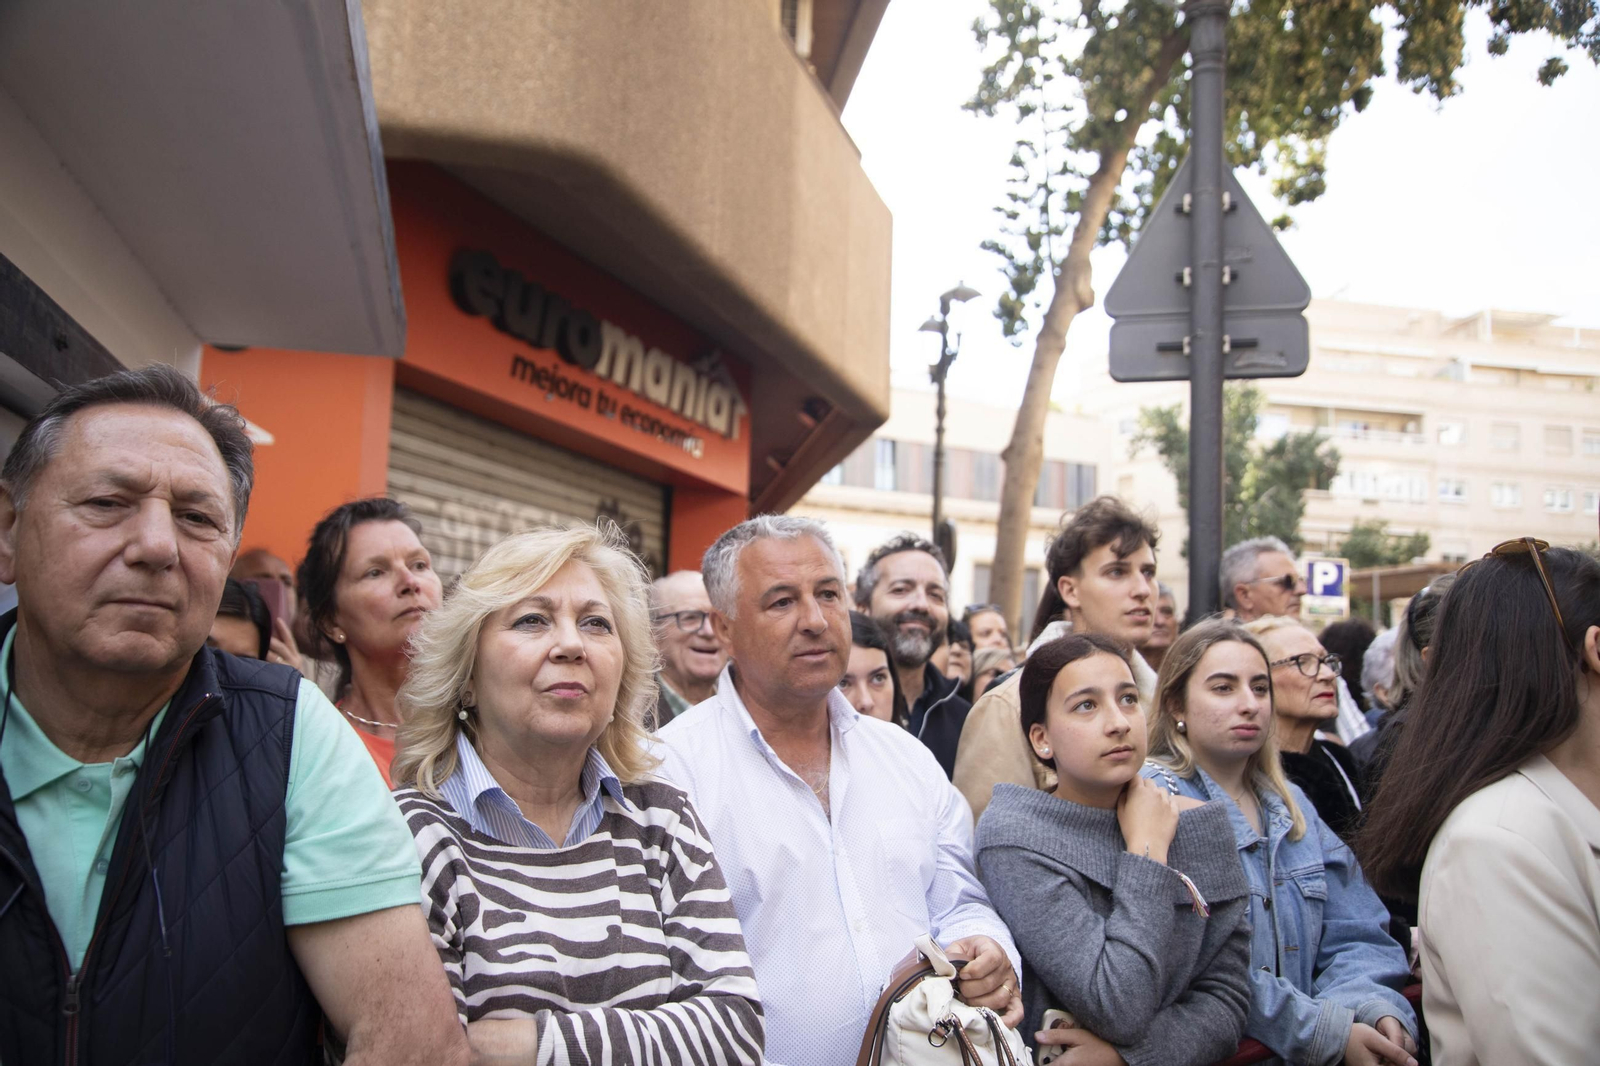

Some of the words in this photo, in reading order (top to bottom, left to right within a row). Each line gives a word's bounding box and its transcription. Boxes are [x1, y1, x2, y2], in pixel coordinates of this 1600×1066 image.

[510, 354, 592, 409] mejora
[597, 388, 617, 418] tu
[1313, 561, 1338, 595] P
